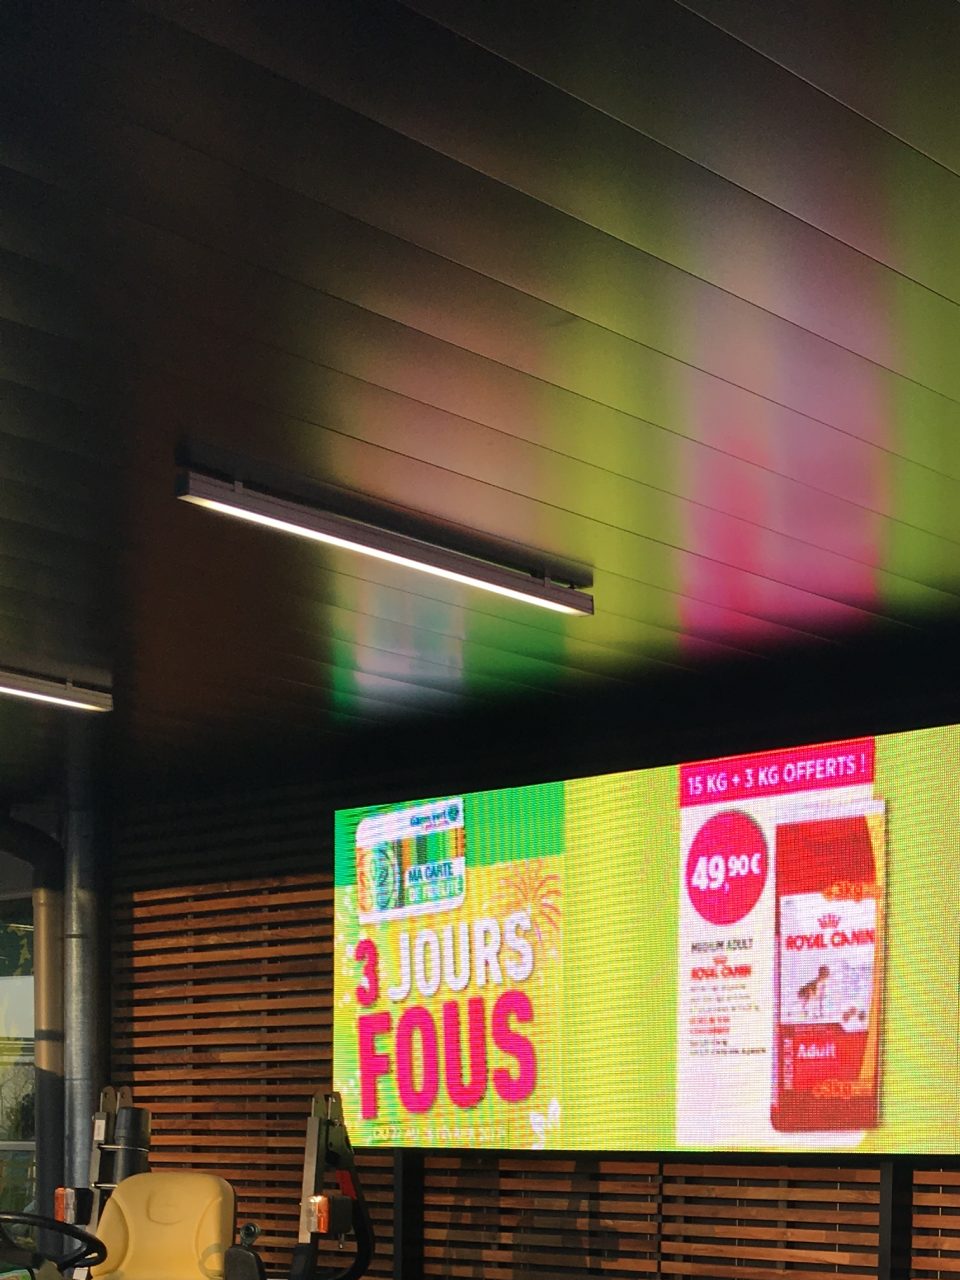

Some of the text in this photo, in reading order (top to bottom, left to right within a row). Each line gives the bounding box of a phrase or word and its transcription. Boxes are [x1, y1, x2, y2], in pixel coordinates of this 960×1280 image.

[688, 776, 703, 795] 15
[707, 773, 728, 792] KG
[744, 769, 753, 787] 3
[758, 766, 779, 785] KG
[783, 755, 856, 783] OFFERTS
[354, 910, 535, 1005] 3 JOURS
[786, 927, 876, 952] ROYAL CANIN
[357, 988, 538, 1120] FOUS
